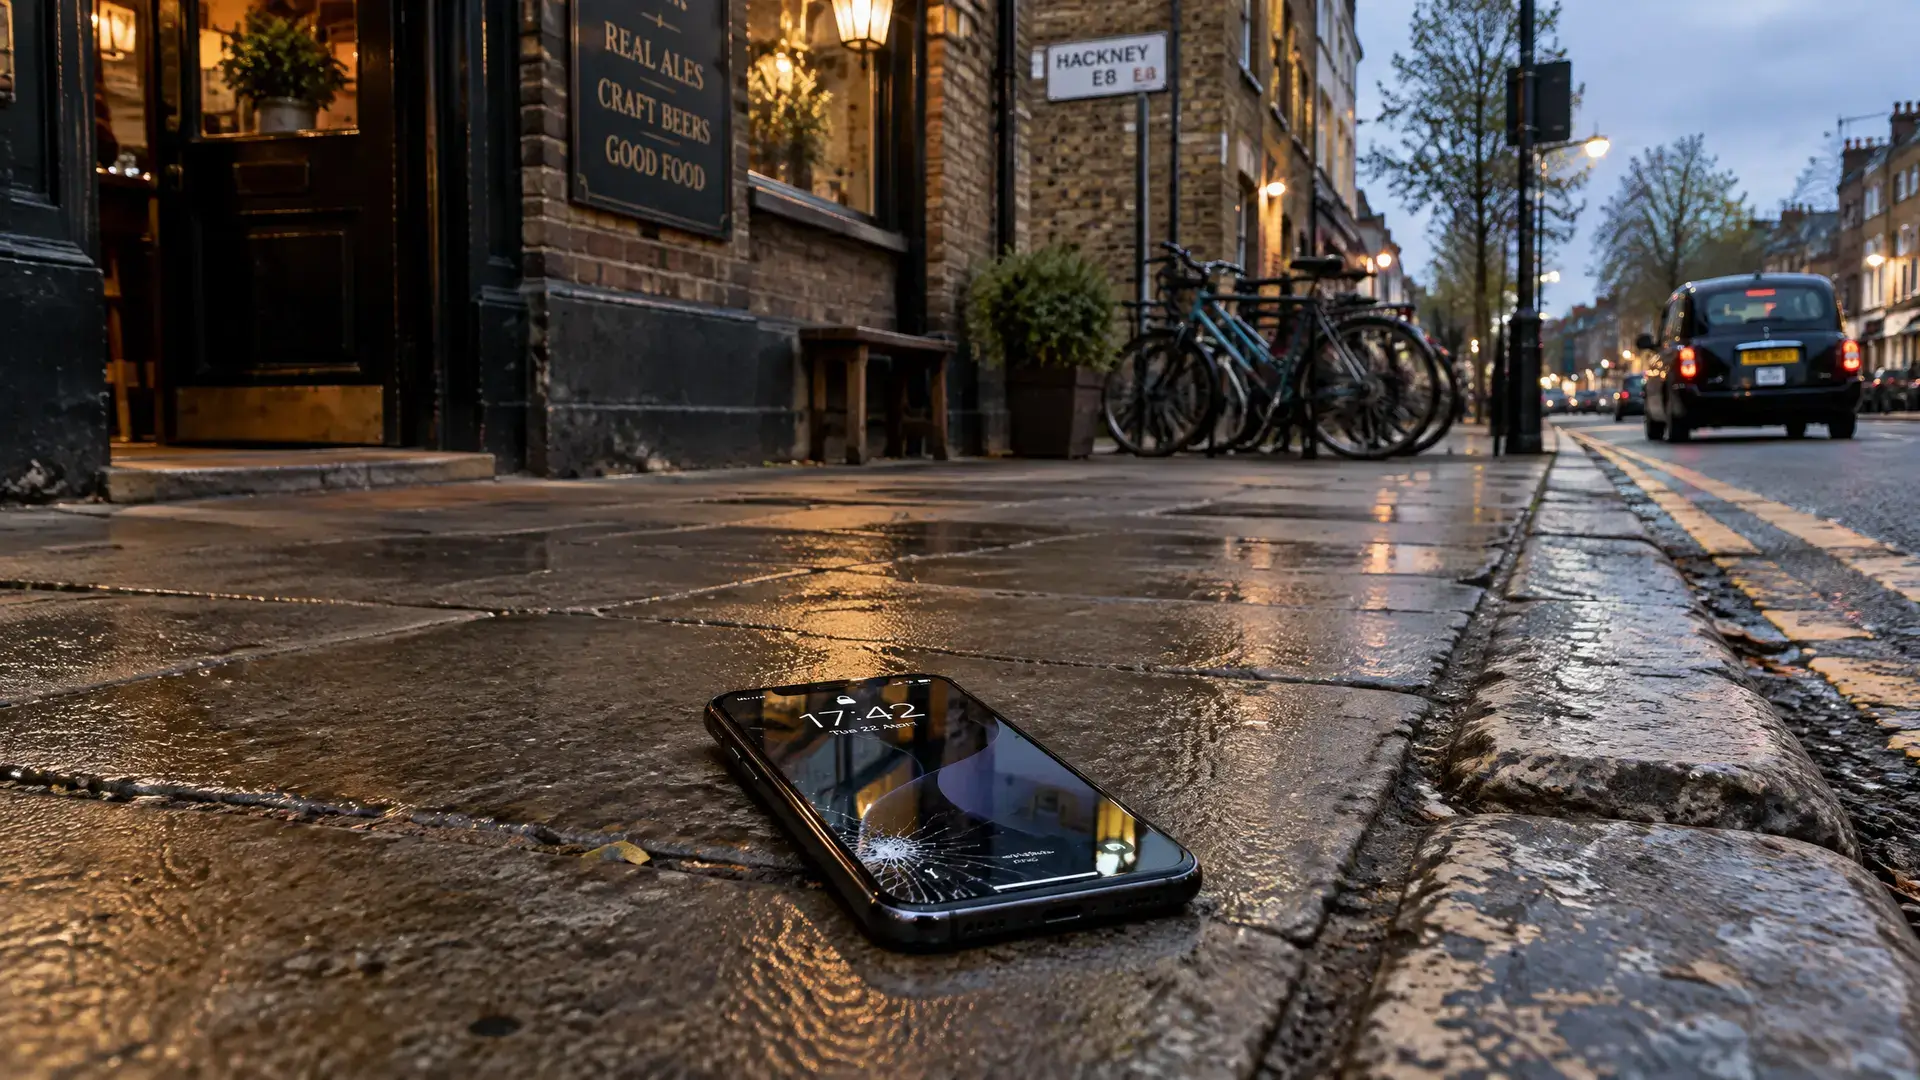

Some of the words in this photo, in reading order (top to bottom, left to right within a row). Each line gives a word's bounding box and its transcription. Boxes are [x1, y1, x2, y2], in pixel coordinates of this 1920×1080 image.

[604, 21, 656, 71] REAL
[659, 48, 704, 91] ALES
[1056, 44, 1149, 69] HACKNEY
[1092, 69, 1117, 86] E8
[597, 77, 656, 124] CRAFT
[661, 103, 711, 145] BEERS
[605, 134, 657, 177] GOOD
[661, 152, 706, 192] FOOD
[799, 702, 926, 729] 17:42
